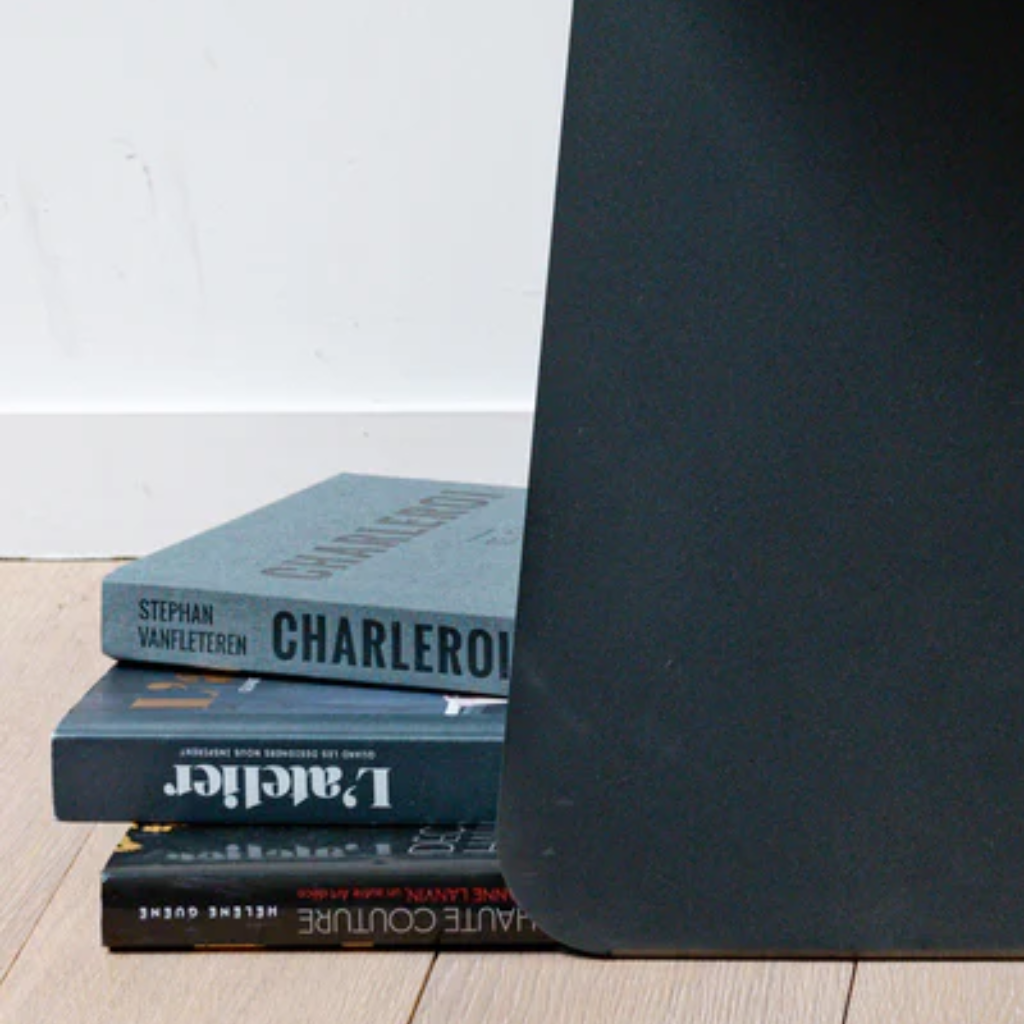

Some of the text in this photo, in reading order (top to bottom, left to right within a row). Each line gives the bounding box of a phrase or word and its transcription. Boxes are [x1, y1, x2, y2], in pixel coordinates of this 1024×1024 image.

[137, 598, 214, 626] STEPHAN
[137, 627, 248, 657] VANFLETEREN
[163, 763, 391, 810] L'atelier
[298, 906, 438, 936] COUTURE
